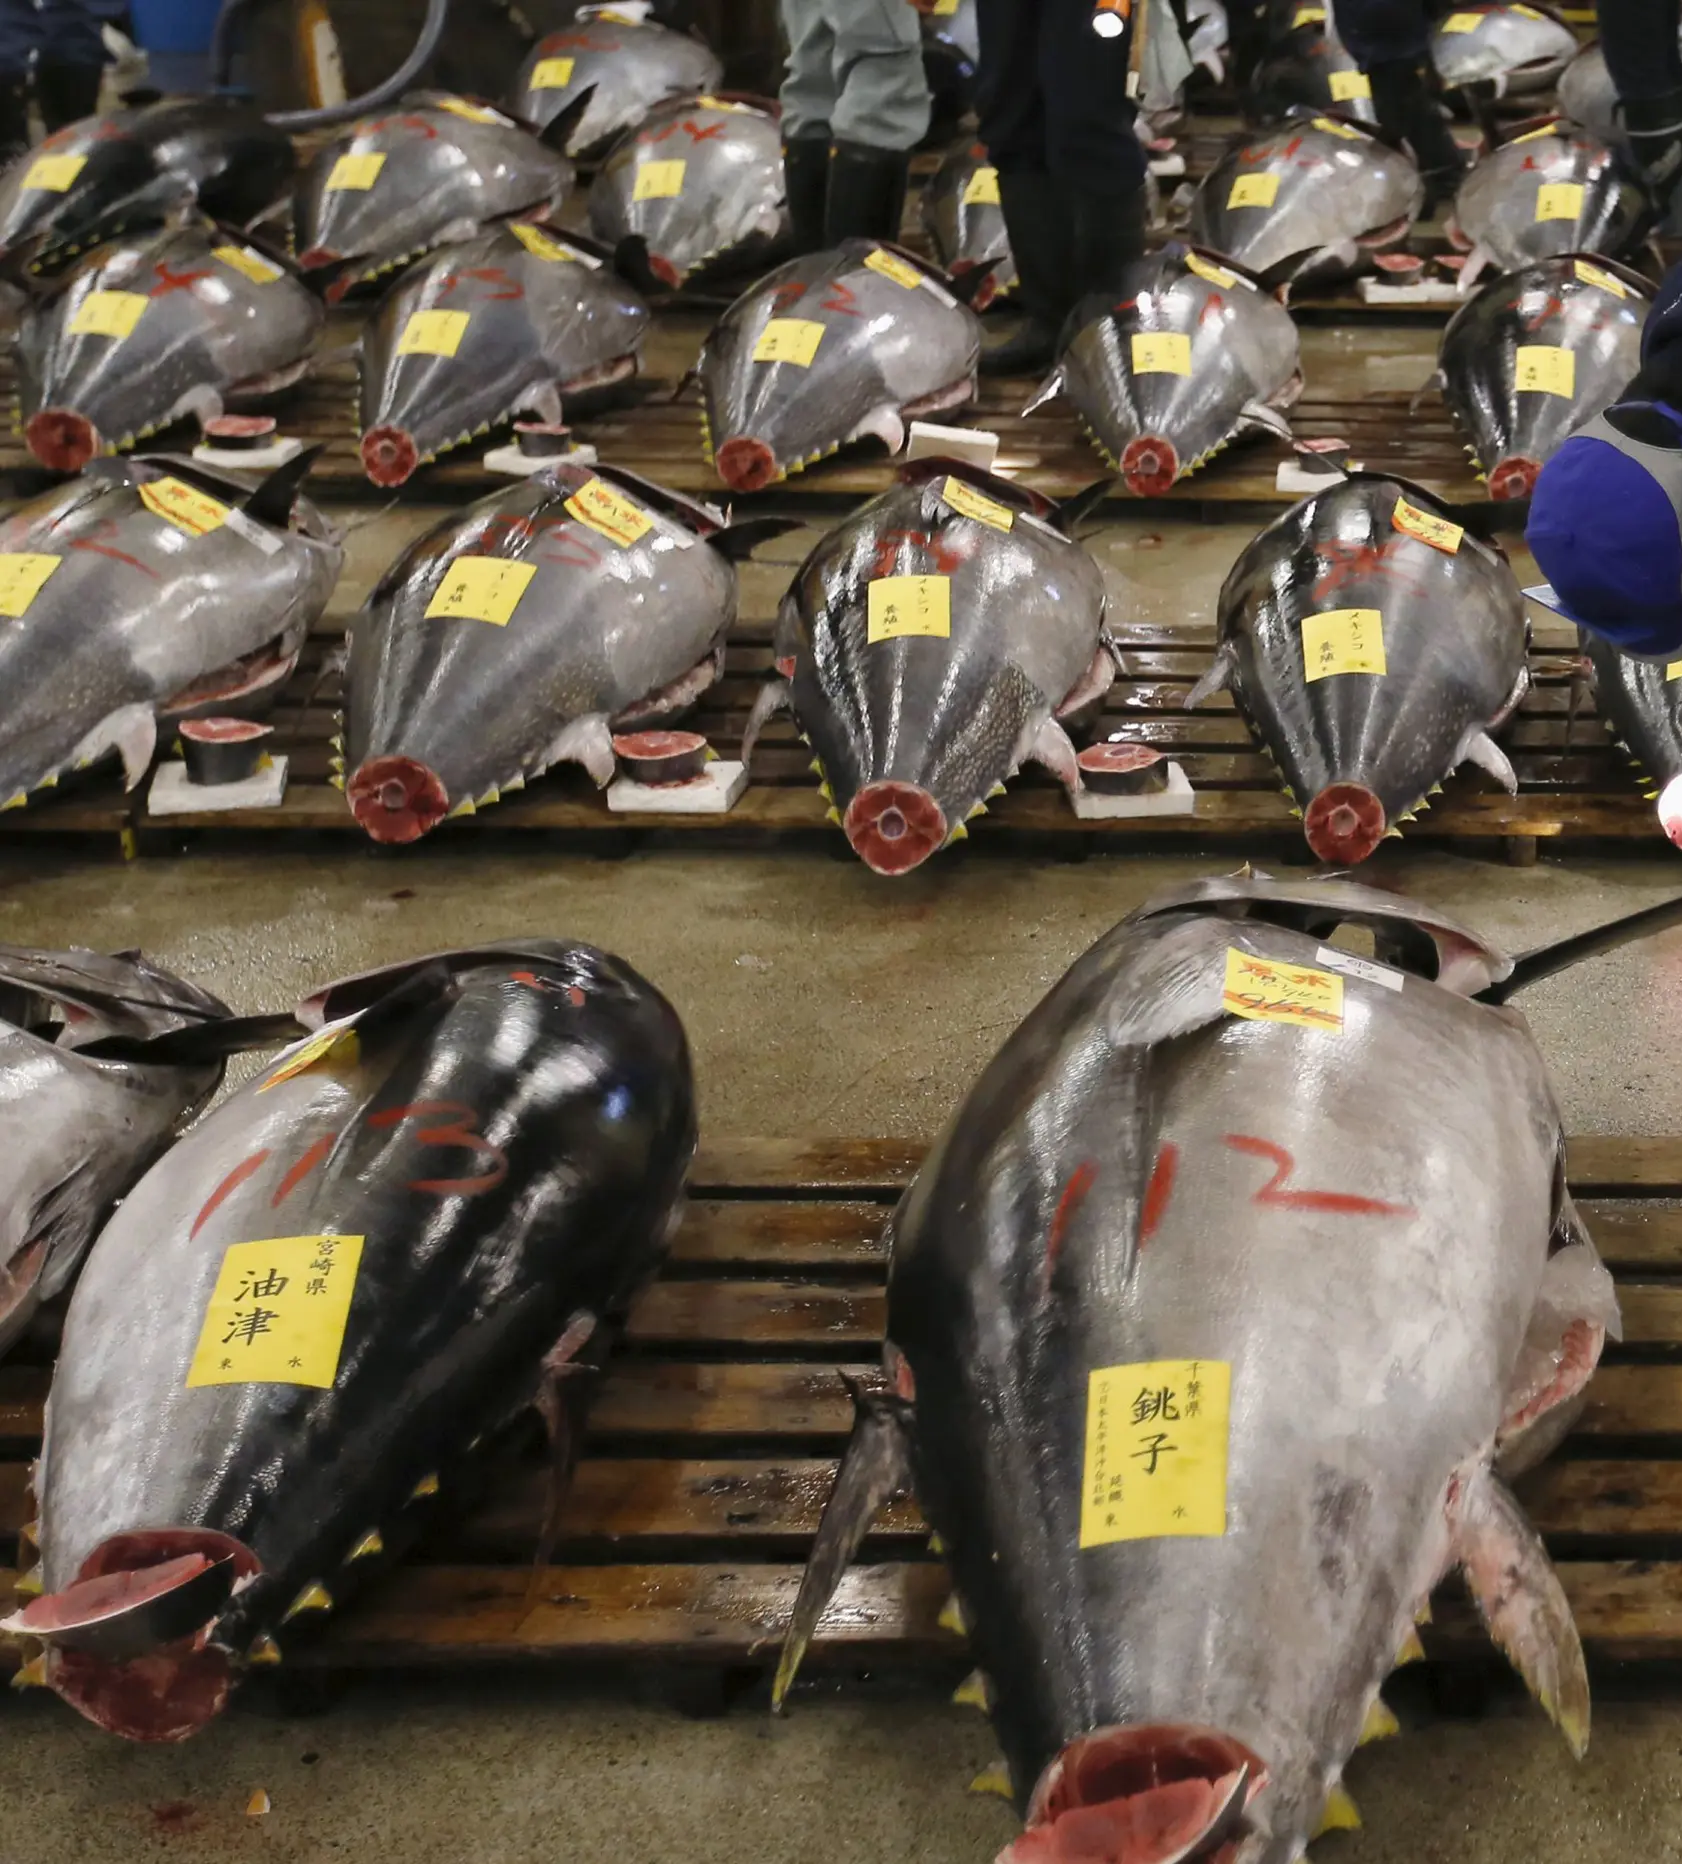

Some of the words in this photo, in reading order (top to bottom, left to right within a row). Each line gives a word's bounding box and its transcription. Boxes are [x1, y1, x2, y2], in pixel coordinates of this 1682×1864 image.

[189, 1101, 509, 1242] 113
[1045, 1132, 1420, 1270] 112
[221, 1267, 290, 1347] 油津
[304, 1238, 341, 1296] 宮崎県
[1129, 1385, 1181, 1476] 銚子
